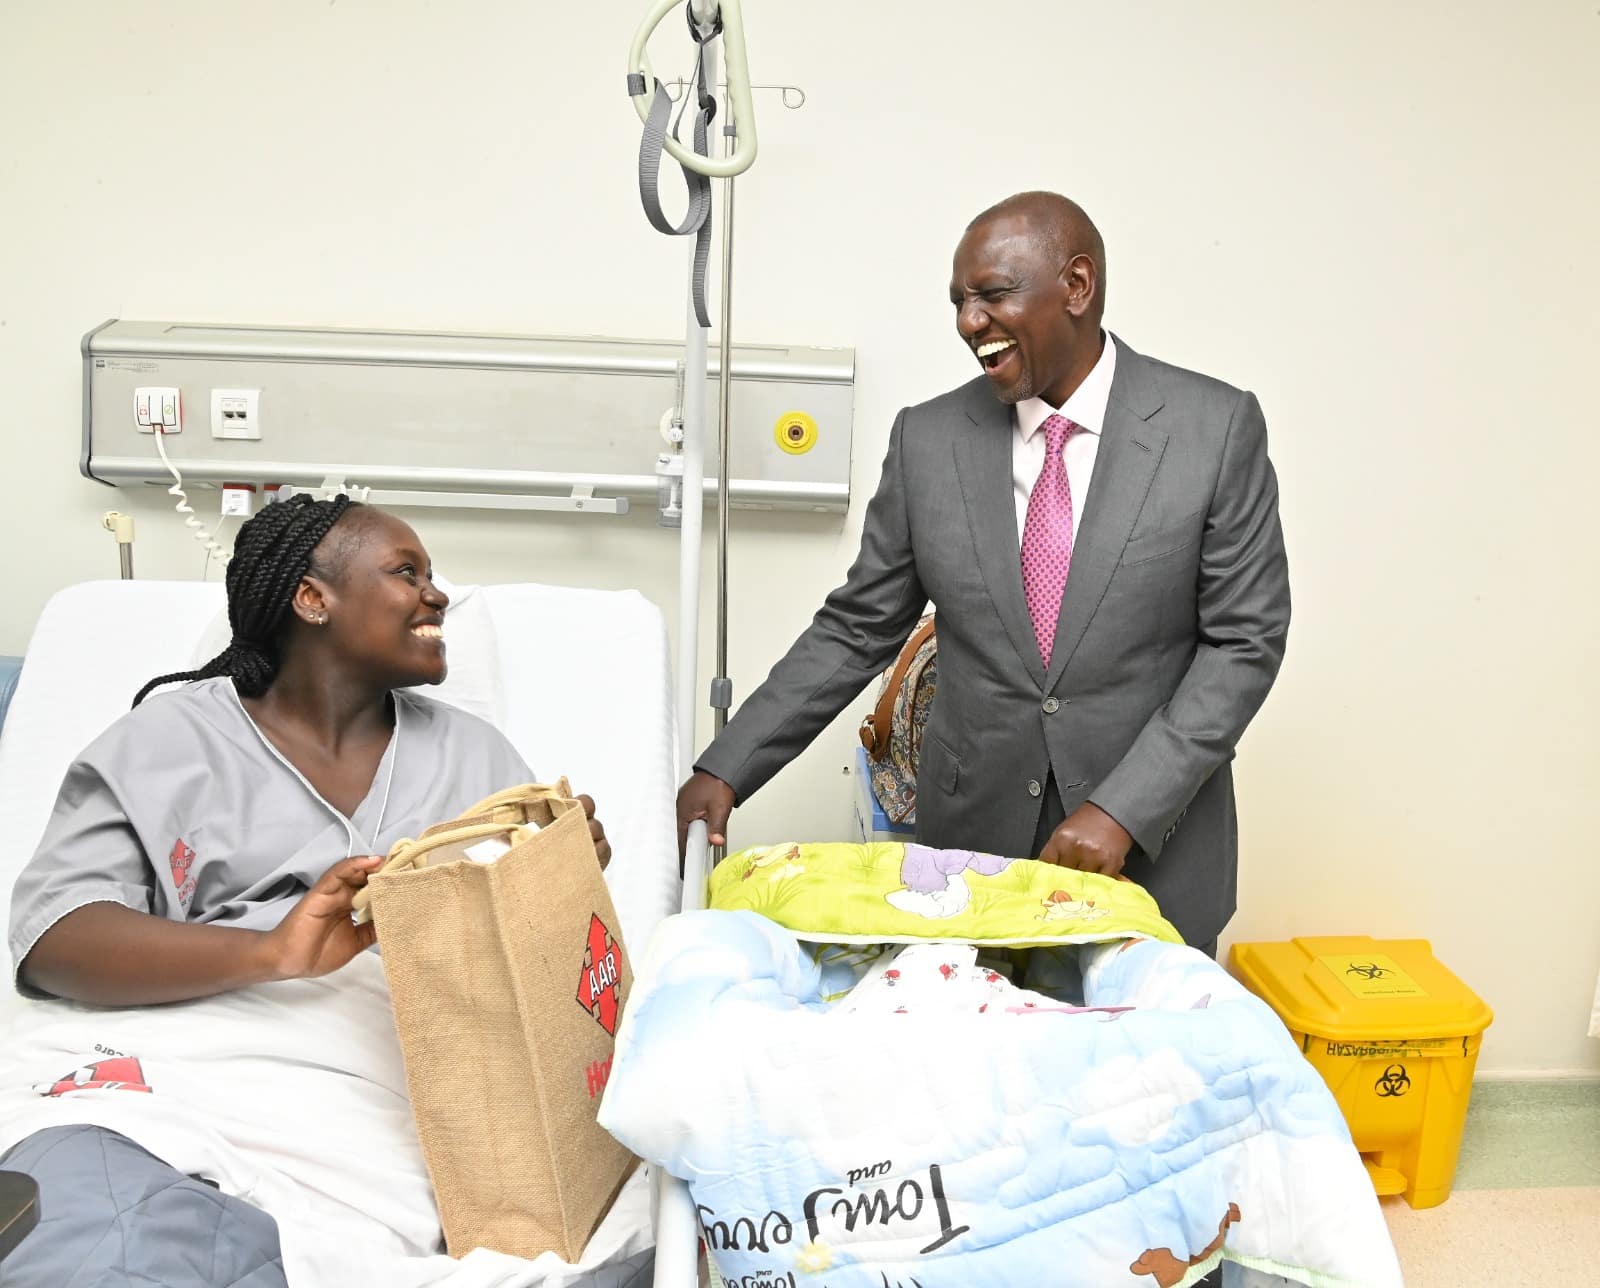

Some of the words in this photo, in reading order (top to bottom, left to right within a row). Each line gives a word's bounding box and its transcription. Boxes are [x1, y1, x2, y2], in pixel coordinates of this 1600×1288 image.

[589, 952, 618, 1001] AAR
[846, 1160, 892, 1187] and
[831, 1163, 970, 1255] Tom
[755, 1269, 773, 1278] and
